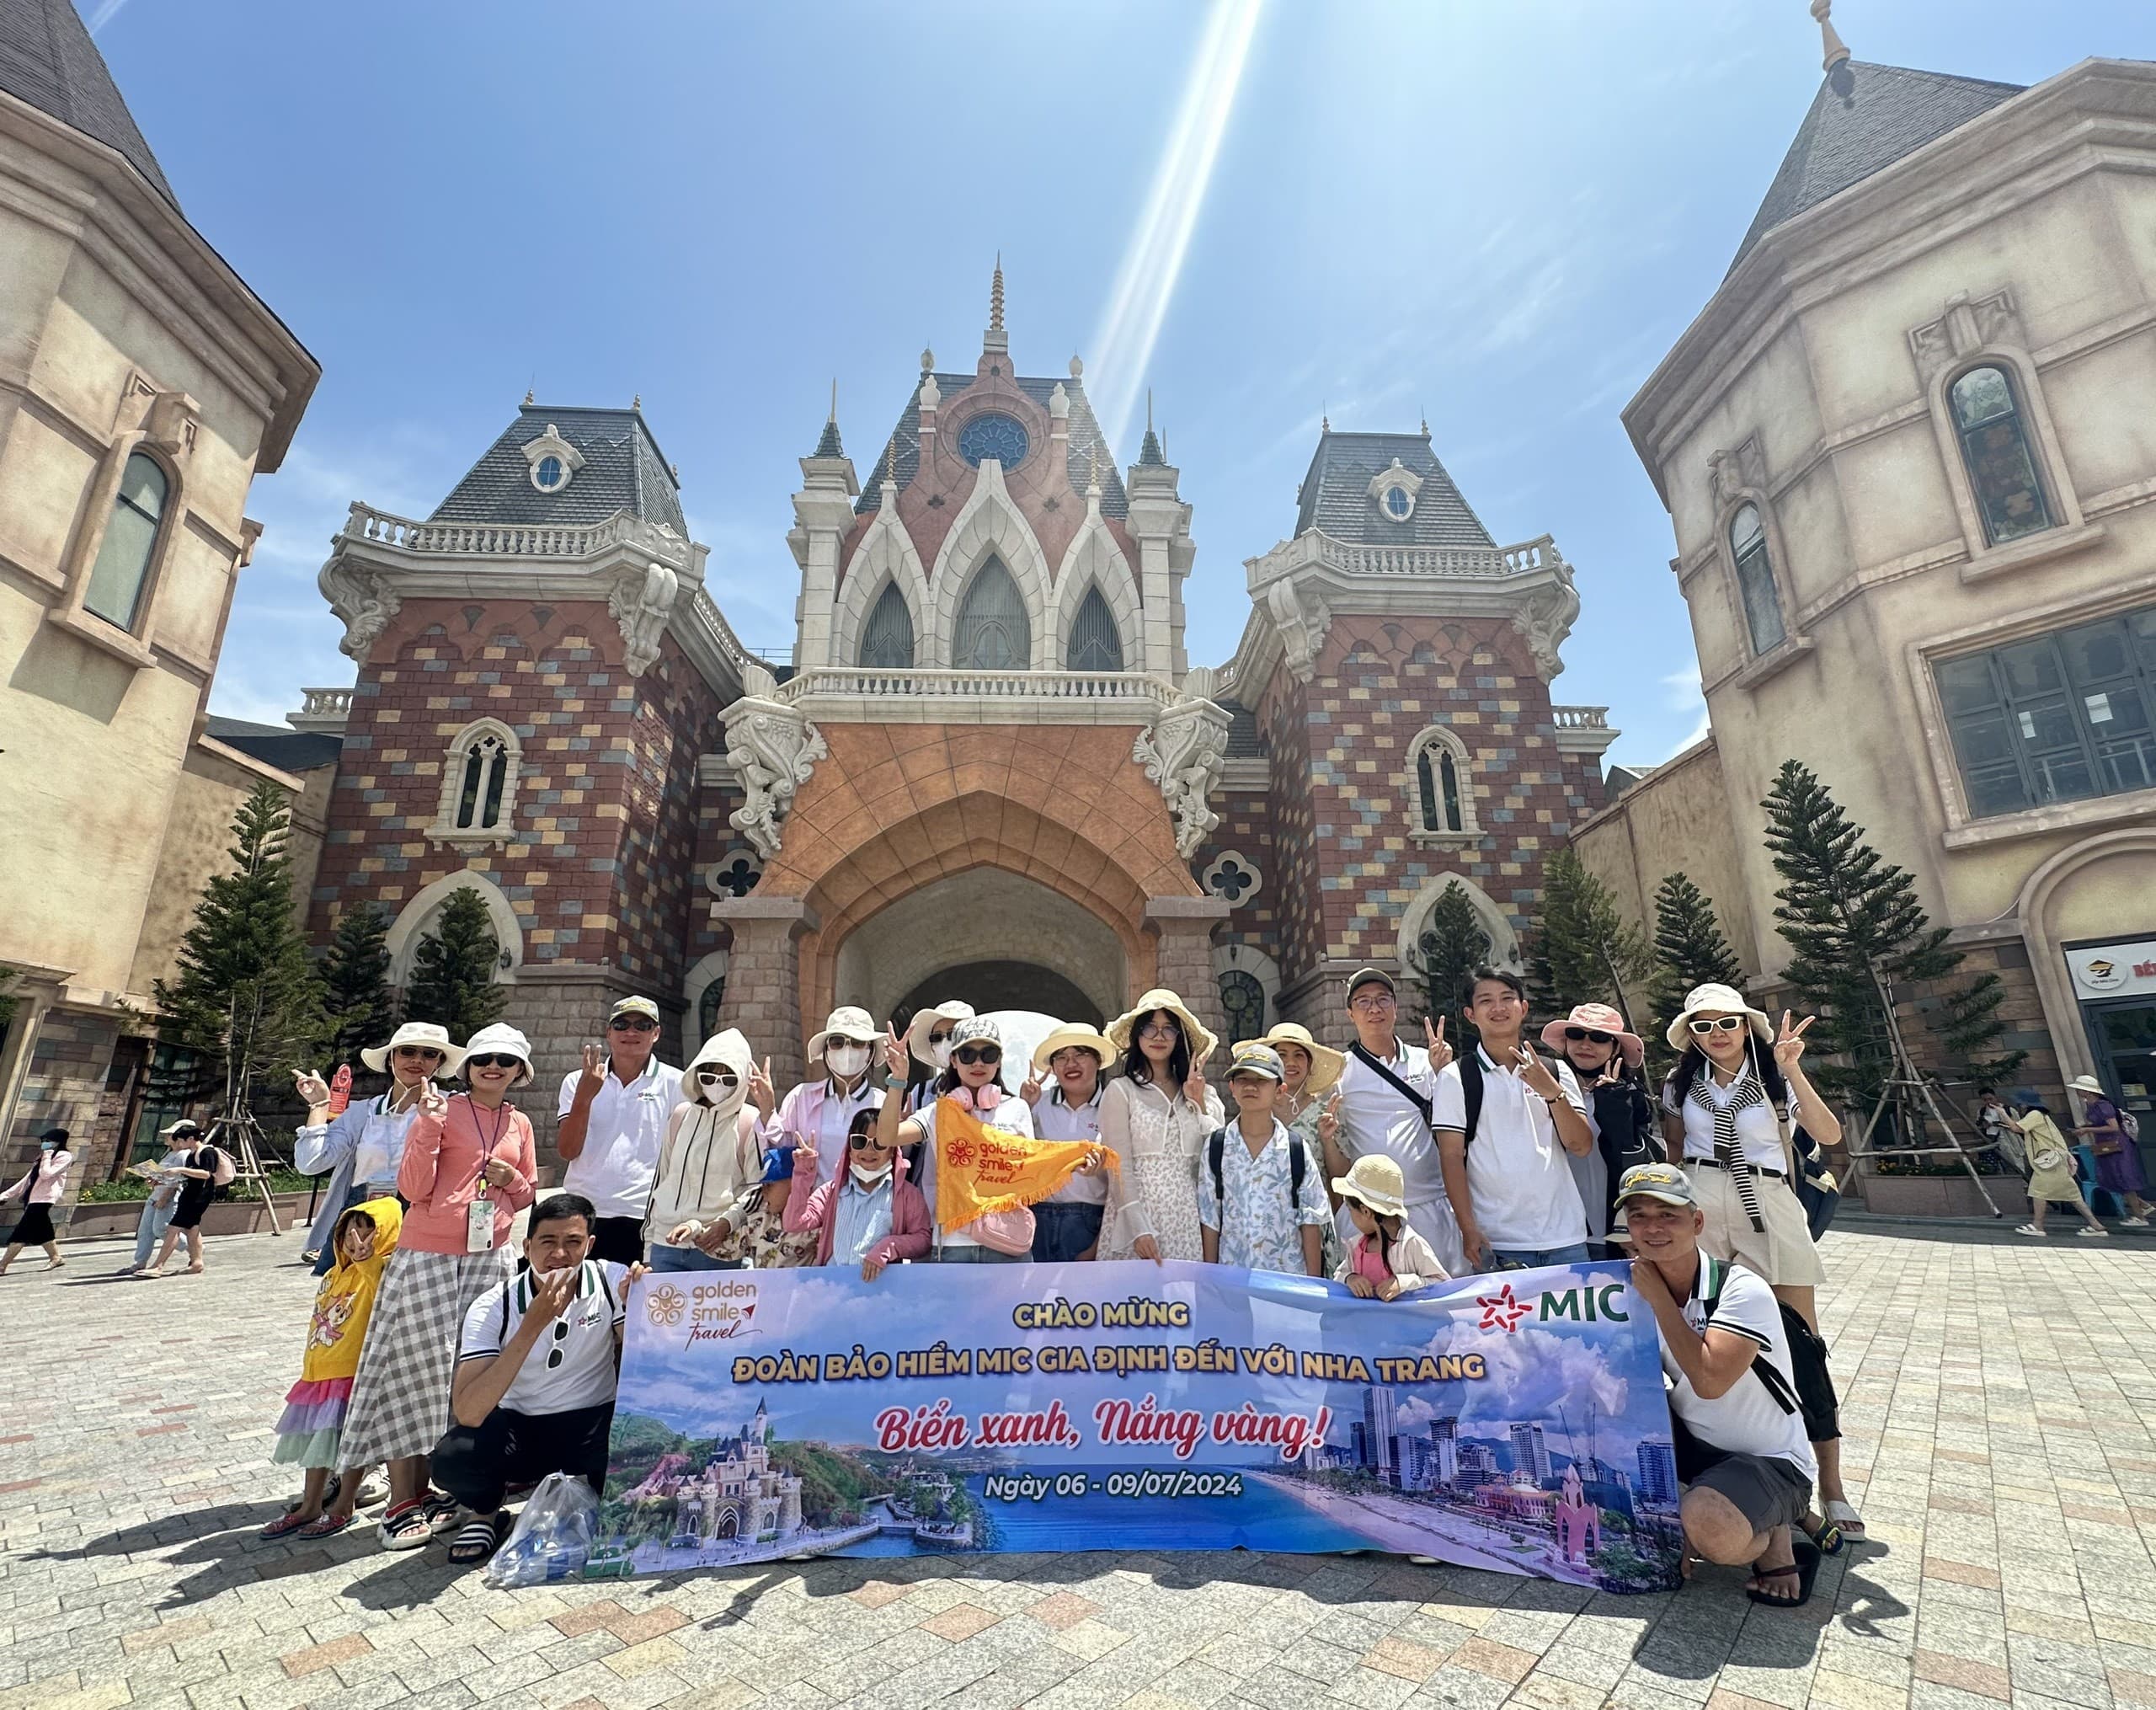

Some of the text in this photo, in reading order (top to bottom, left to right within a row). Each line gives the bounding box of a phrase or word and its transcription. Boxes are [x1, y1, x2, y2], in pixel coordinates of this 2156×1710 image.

[979, 1142, 1027, 1157] golden
[979, 1158, 1012, 1171] smile
[692, 1280, 756, 1305] golden
[1540, 1284, 1629, 1322] MIC
[691, 1303, 739, 1321] smile
[1013, 1296, 1189, 1328] CHÀO MỪNG
[685, 1320, 762, 1351] travel
[731, 1338, 1486, 1382] ĐOÀN BẢO HIỂM MIC GIA ĐỊNH ĐẾN VỚI NHA TRANG
[876, 1393, 1331, 1461] Biển xanh, Nắng vàng!
[985, 1475, 1050, 1499] Ngày
[1056, 1474, 1086, 1495] 06
[1107, 1472, 1241, 1496] 09/07/2024
